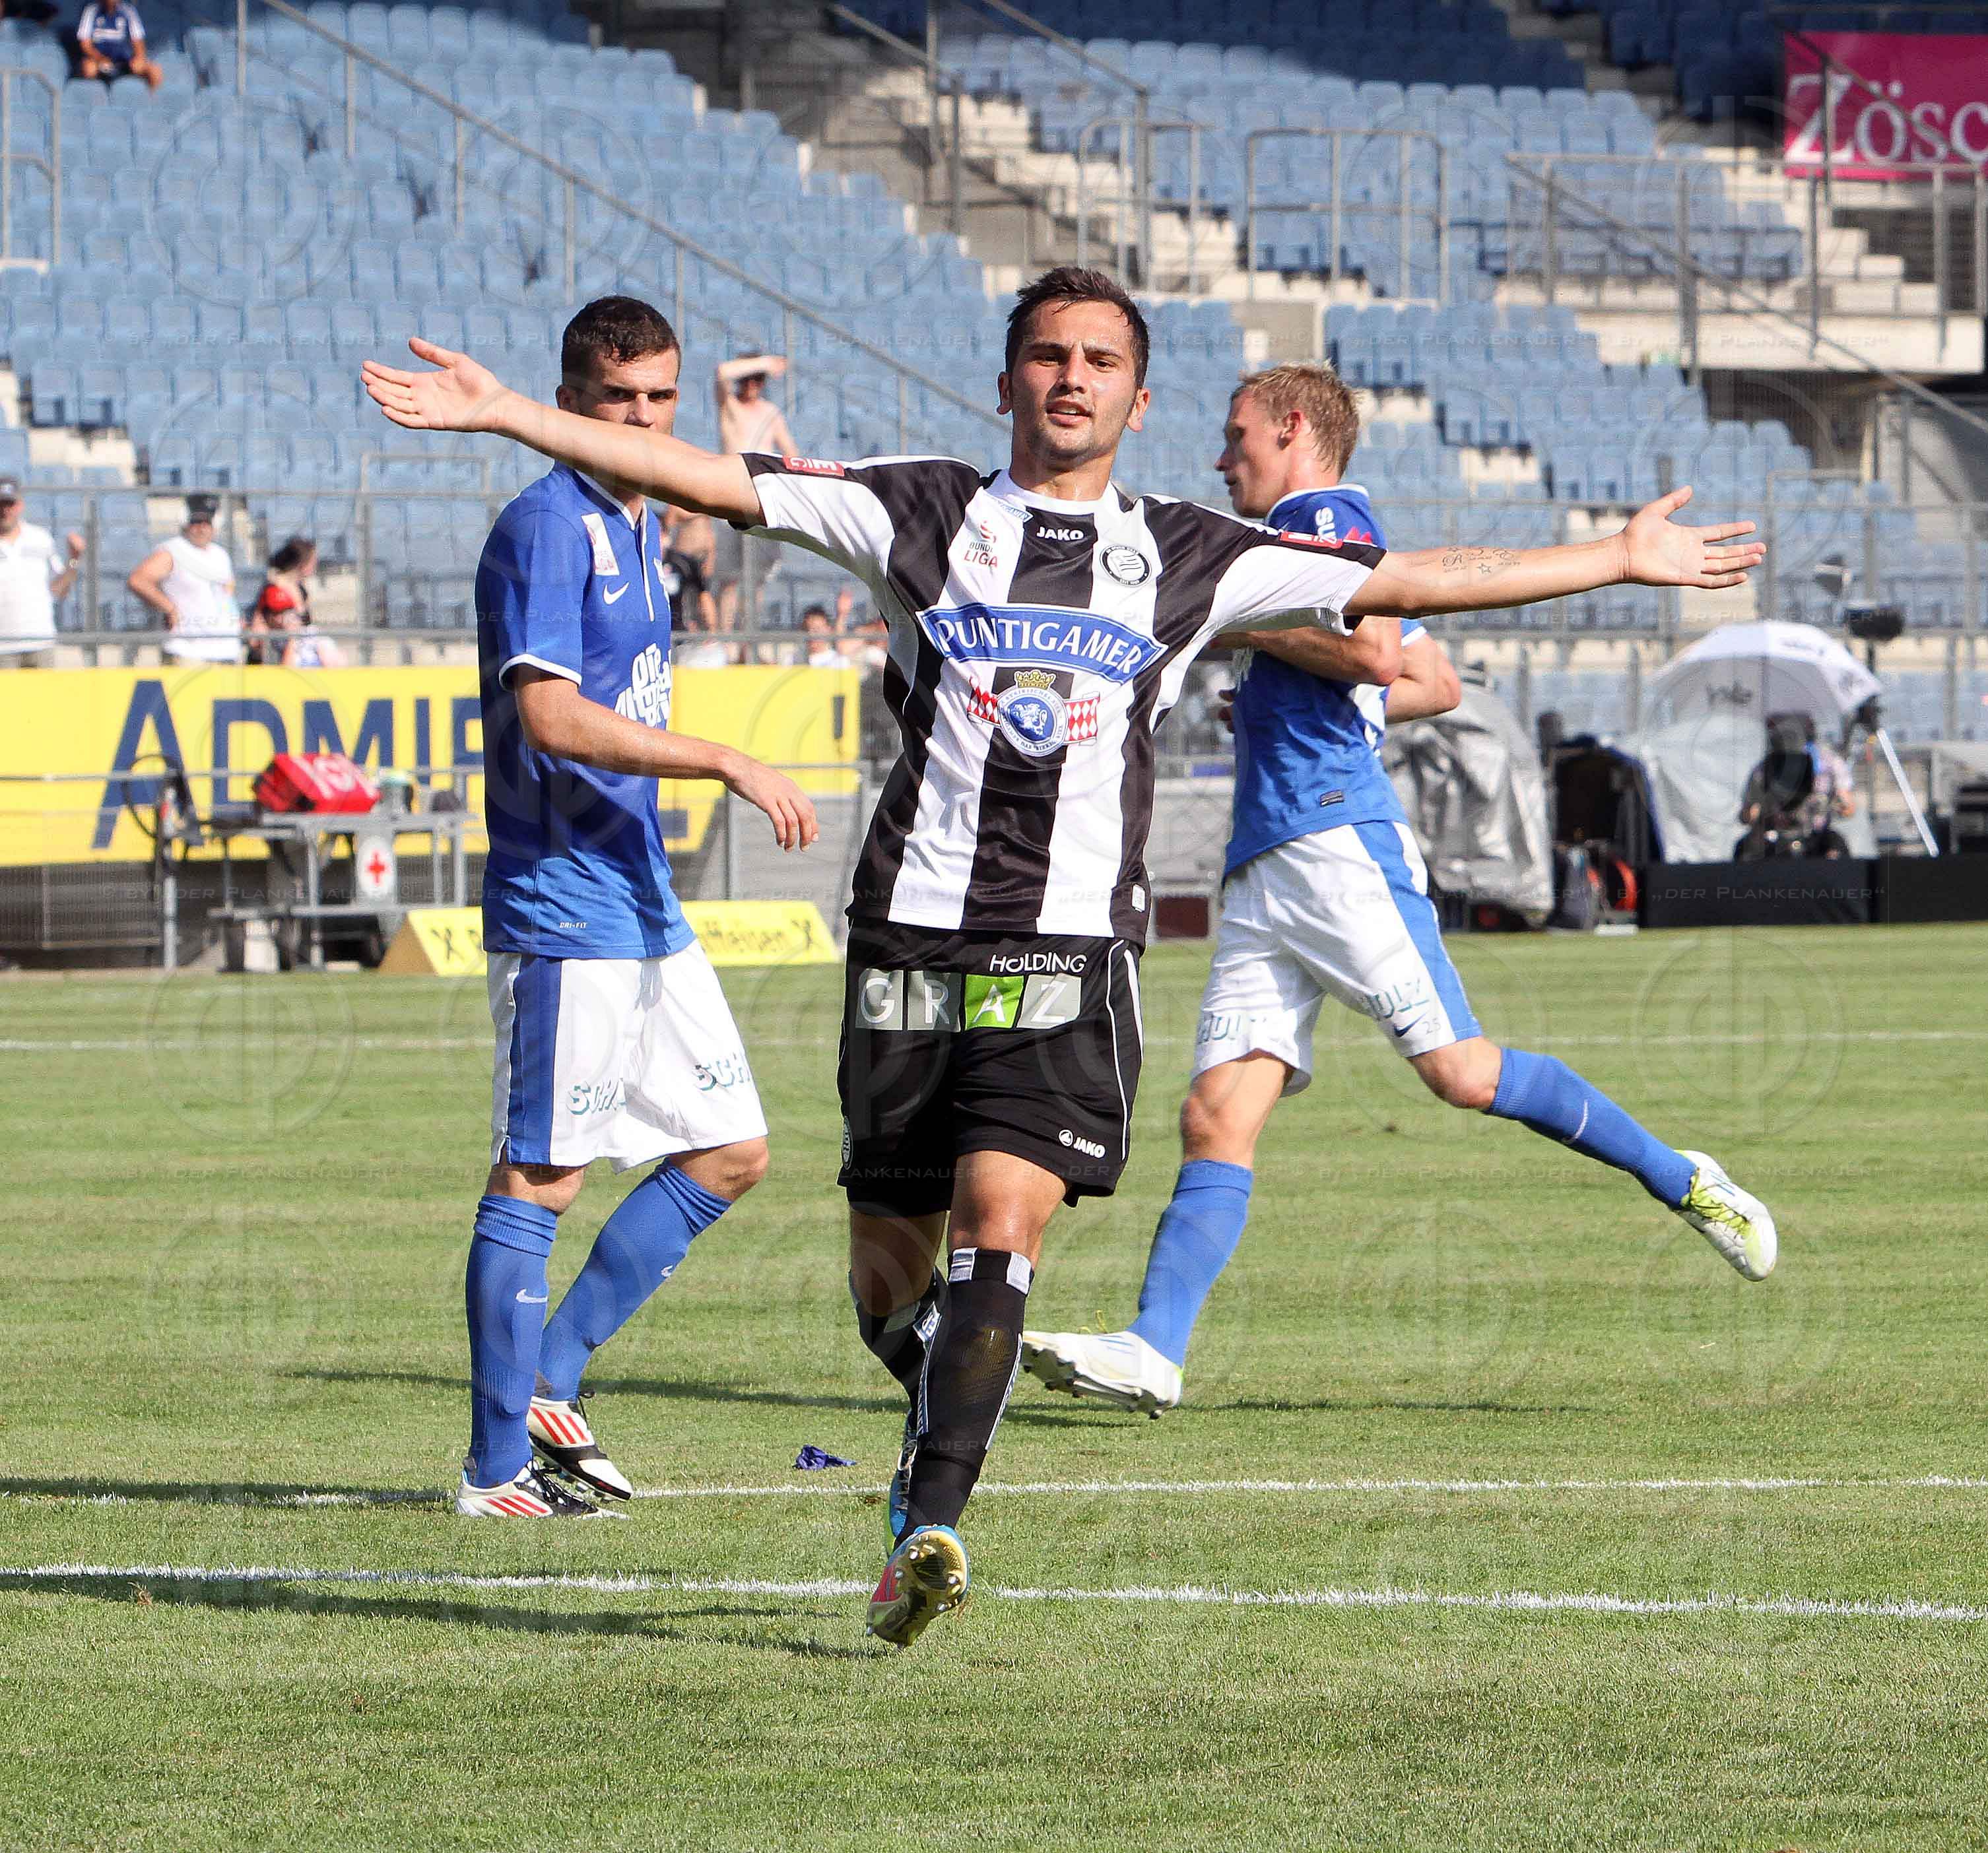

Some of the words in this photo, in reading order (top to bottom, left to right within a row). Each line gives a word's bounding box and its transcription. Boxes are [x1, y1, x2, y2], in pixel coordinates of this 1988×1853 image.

[1036, 526, 1084, 541] JAKO
[964, 549, 999, 568] LIGA
[935, 616, 1143, 674] PUNTIGAMER
[989, 952, 1088, 973] HOLDING
[860, 977, 1069, 1025] GRAZ
[1073, 1136, 1106, 1159] JAKO
